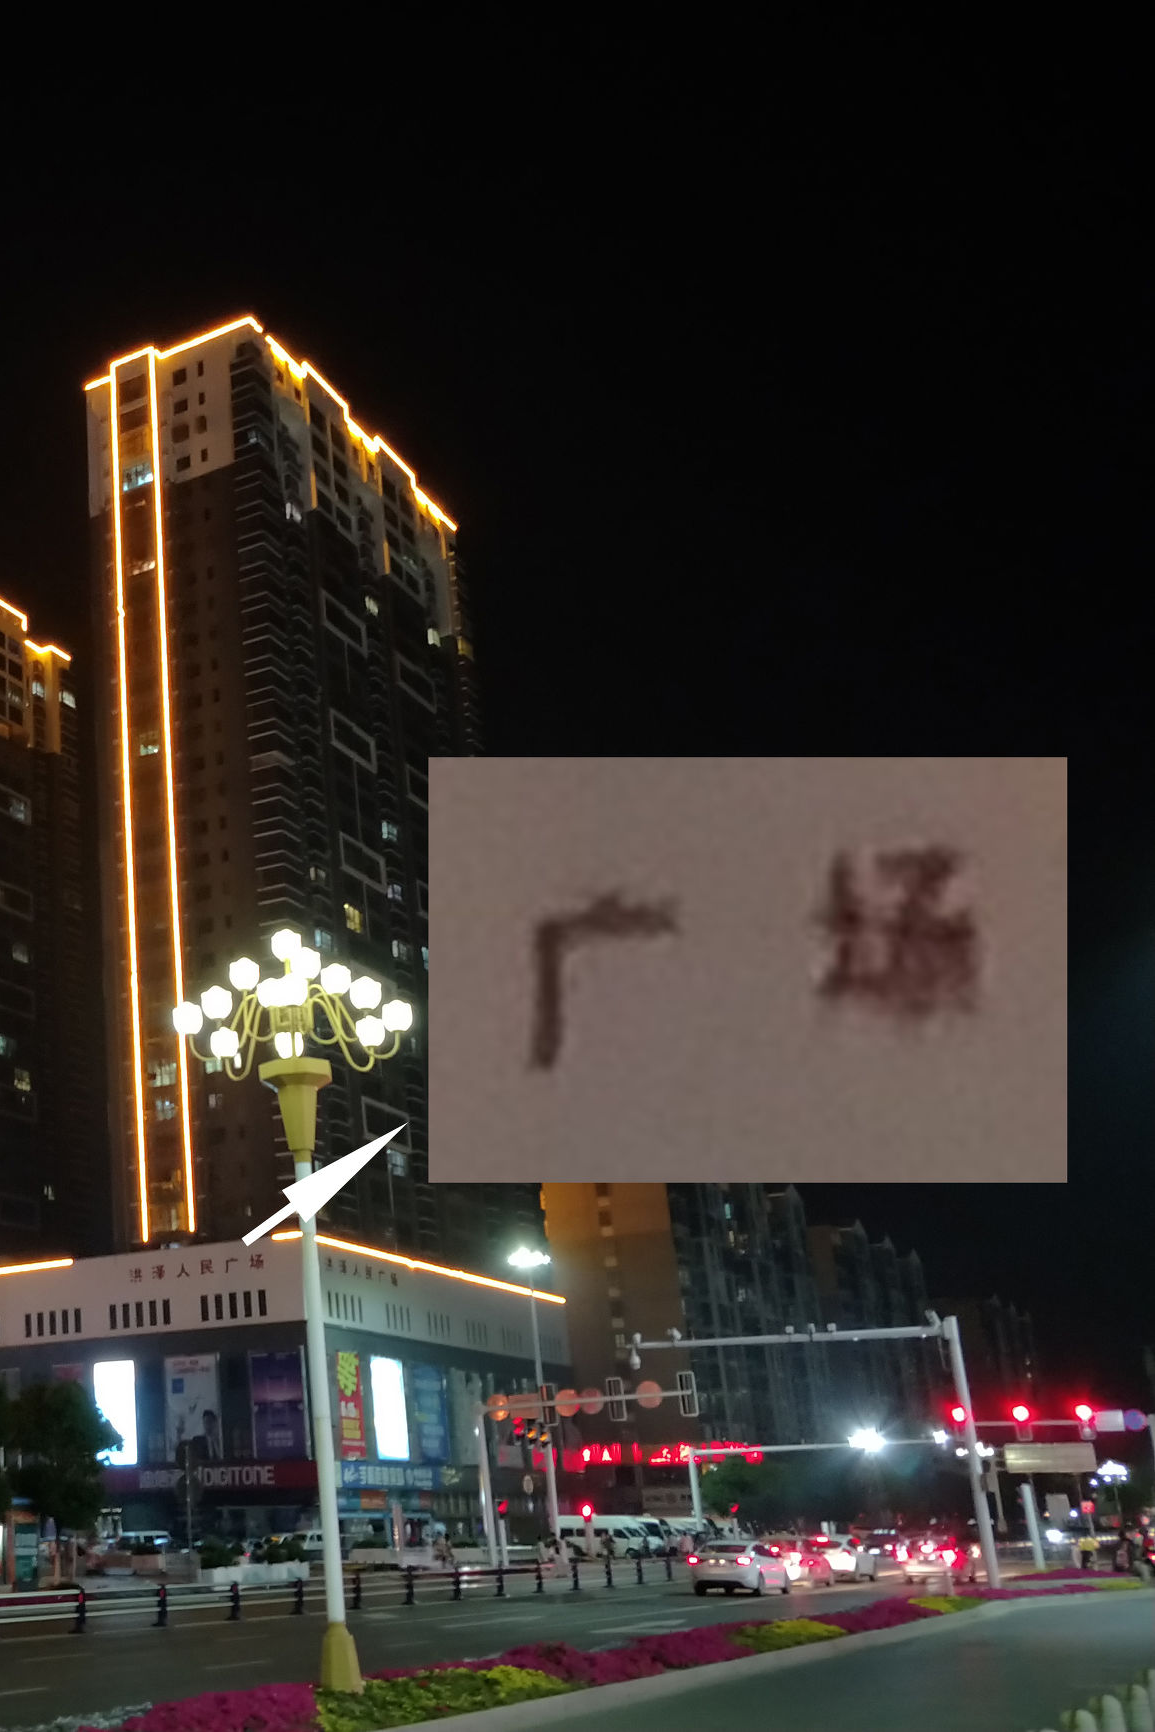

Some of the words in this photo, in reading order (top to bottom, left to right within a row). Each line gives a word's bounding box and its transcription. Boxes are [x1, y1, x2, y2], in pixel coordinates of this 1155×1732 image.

[129, 1254, 264, 1283] 洪泽人民广场
